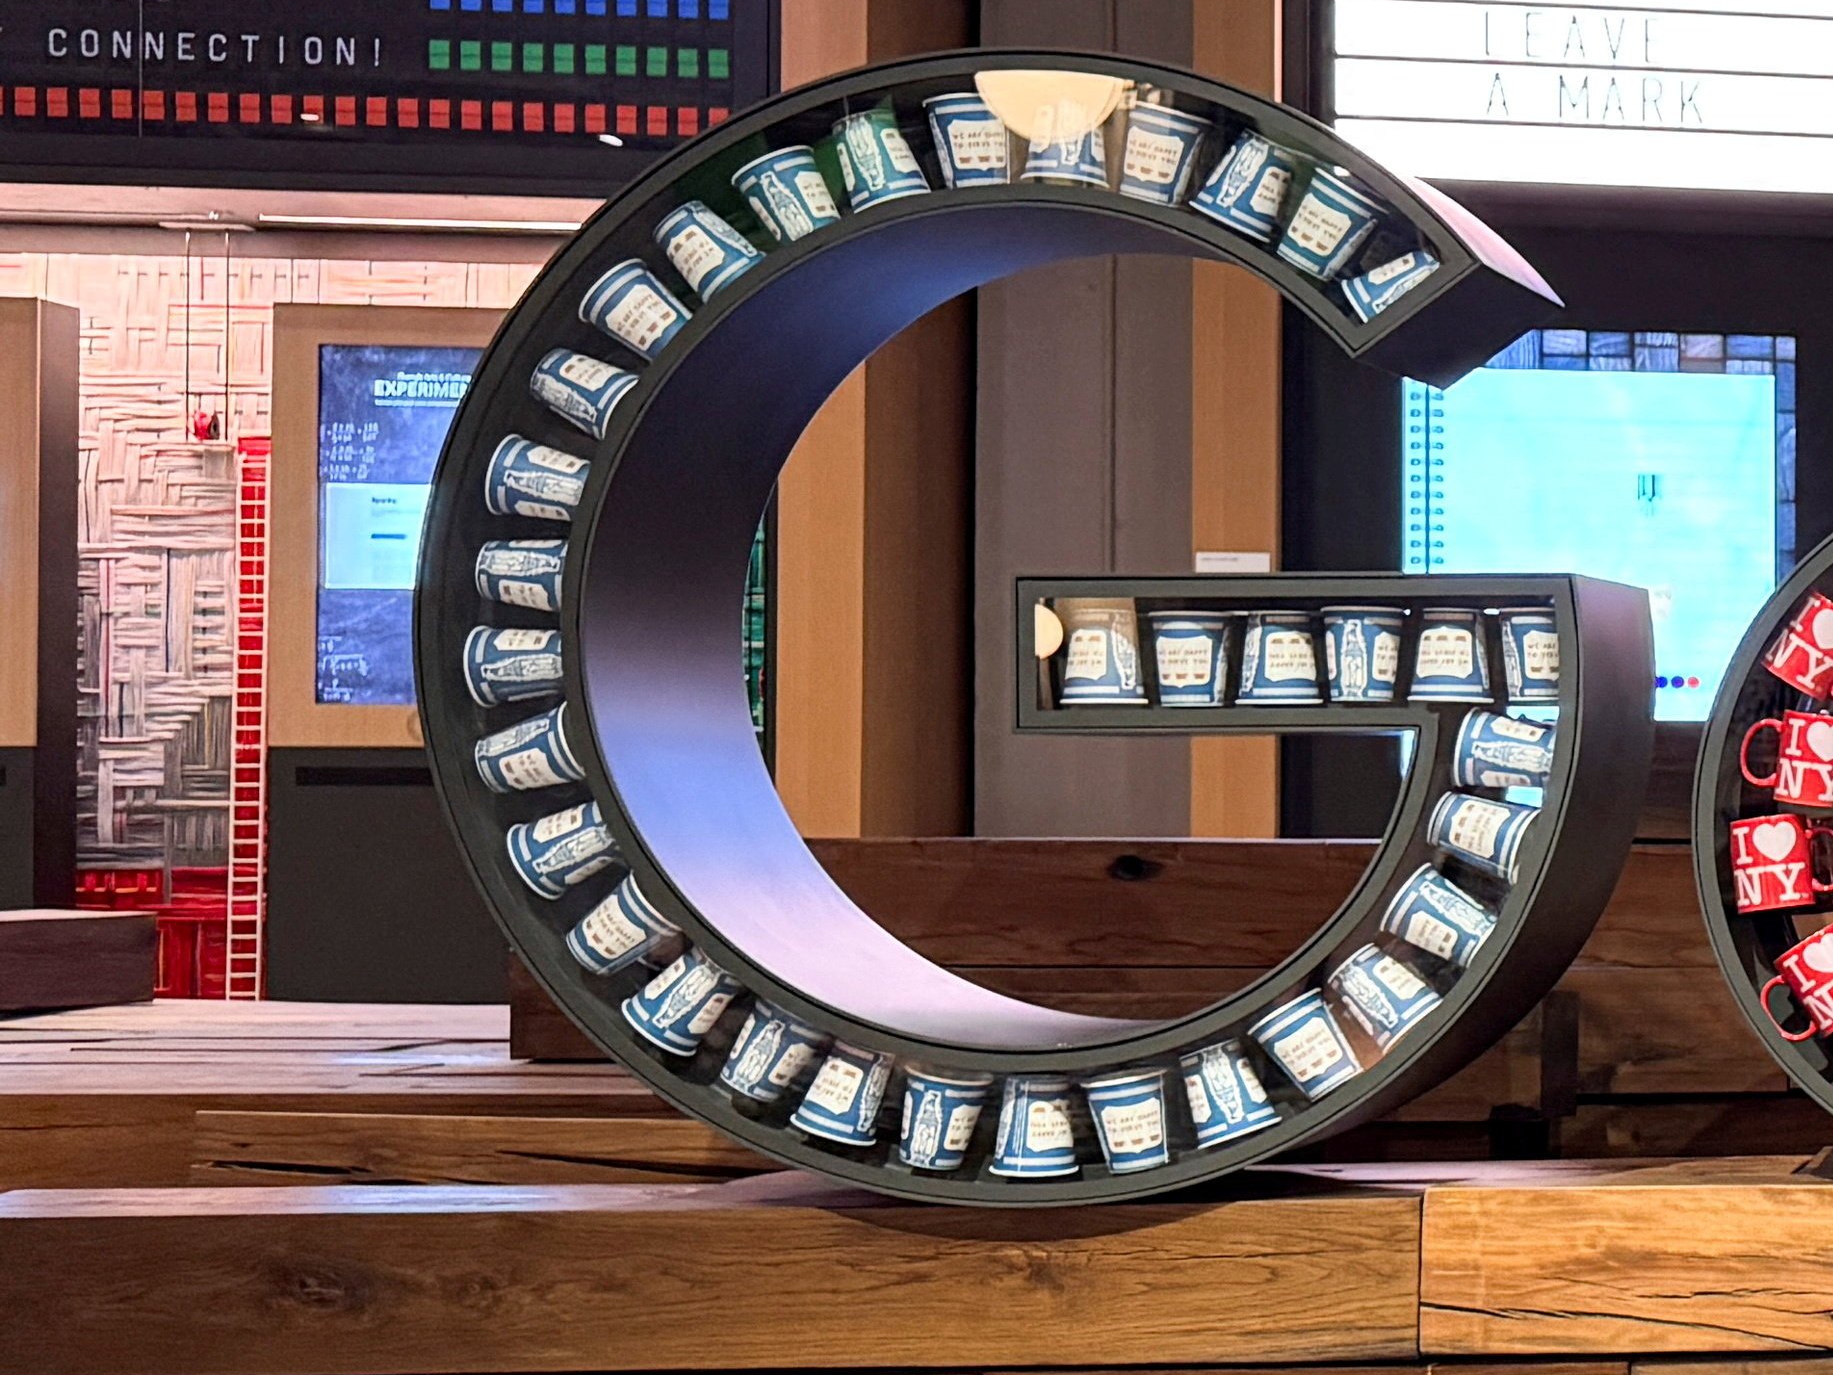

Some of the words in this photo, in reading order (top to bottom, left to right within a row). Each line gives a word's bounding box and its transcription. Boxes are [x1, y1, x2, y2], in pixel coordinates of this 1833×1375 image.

[47, 28, 382, 67] CONNECTION!
[1486, 72, 1509, 116] A
[1558, 74, 1703, 124] MARK
[1789, 597, 1822, 632] I
[1784, 717, 1806, 756] I
[1732, 825, 1754, 865] I
[1732, 861, 1806, 908] NY
[1782, 953, 1817, 993] I
